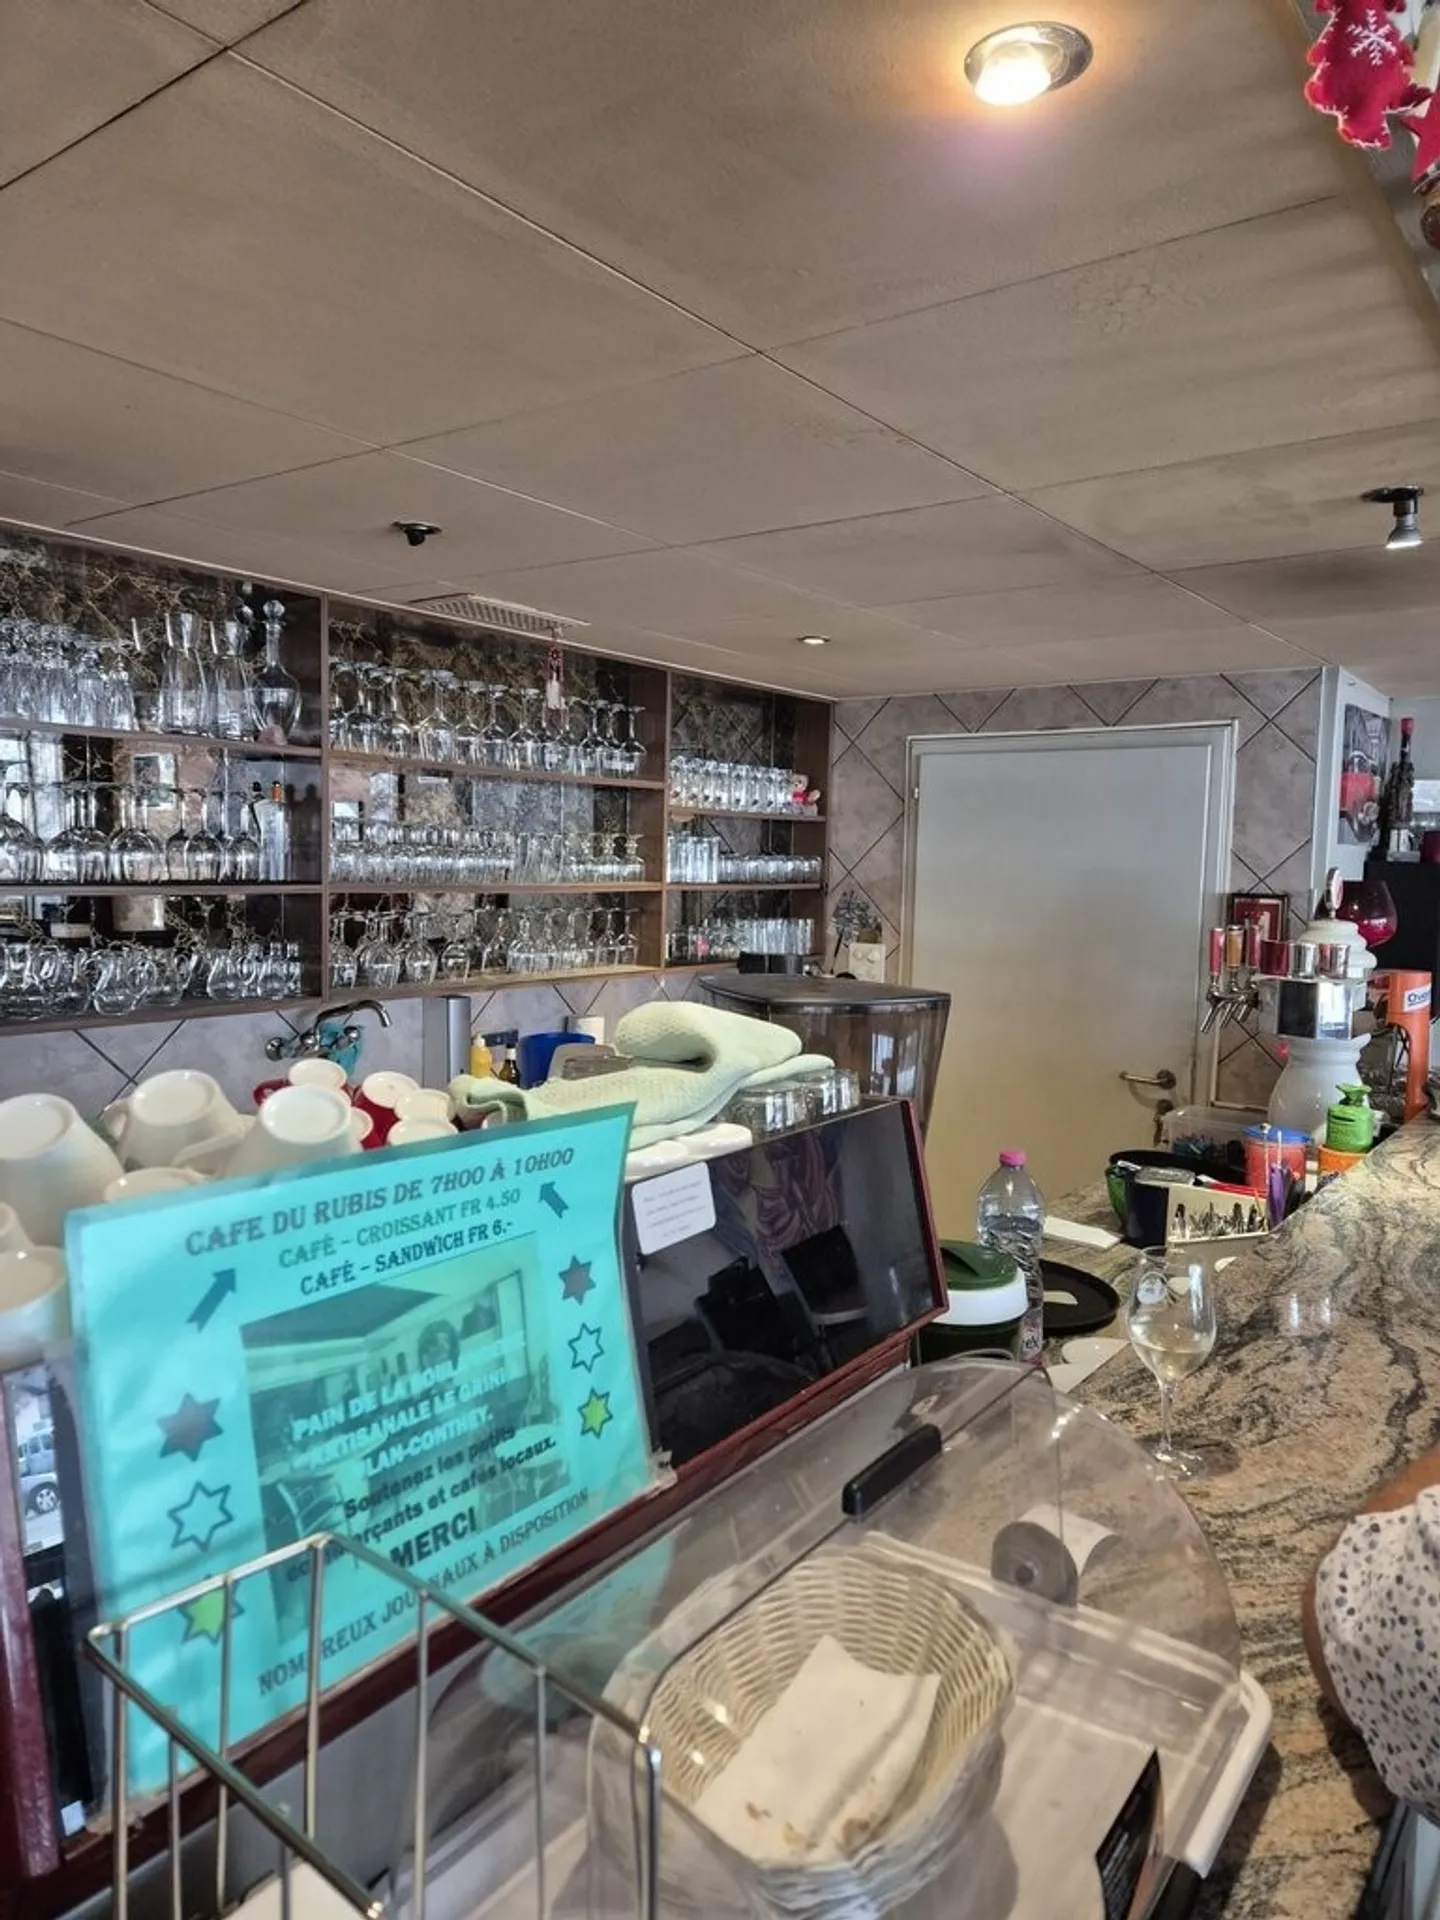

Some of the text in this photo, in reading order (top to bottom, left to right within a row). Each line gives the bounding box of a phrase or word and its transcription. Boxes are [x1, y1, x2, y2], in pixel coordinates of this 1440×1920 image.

[185, 1215, 265, 1257] CAFE
[272, 1204, 307, 1236] DU
[314, 1186, 388, 1225] RUBIS
[392, 1179, 423, 1205] DE
[489, 1157, 505, 1181] À
[279, 1233, 338, 1269] CAFÉ
[356, 1203, 457, 1247] CROISSANT
[460, 1198, 482, 1218] FR
[485, 1188, 521, 1211] 4.50
[300, 1259, 357, 1296] CAFÉ
[375, 1229, 465, 1272] SANDWICH
[468, 1222, 489, 1244] FR
[491, 1218, 514, 1237] 6.-
[291, 1404, 344, 1441] PAIN
[348, 1391, 377, 1419] DE
[380, 1376, 408, 1406] LA
[433, 1389, 457, 1415] LE
[364, 1403, 494, 1479] LAN-CONTHEY.
[427, 1485, 448, 1510] et
[450, 1461, 498, 1497] cafés
[499, 1436, 557, 1473] locaux.
[344, 1464, 434, 1520] Soutenez
[437, 1452, 465, 1474] les
[389, 1506, 477, 1570] MERCI
[257, 1486, 590, 1697] NOMREUX JOUNAUX À DISPOSITION
